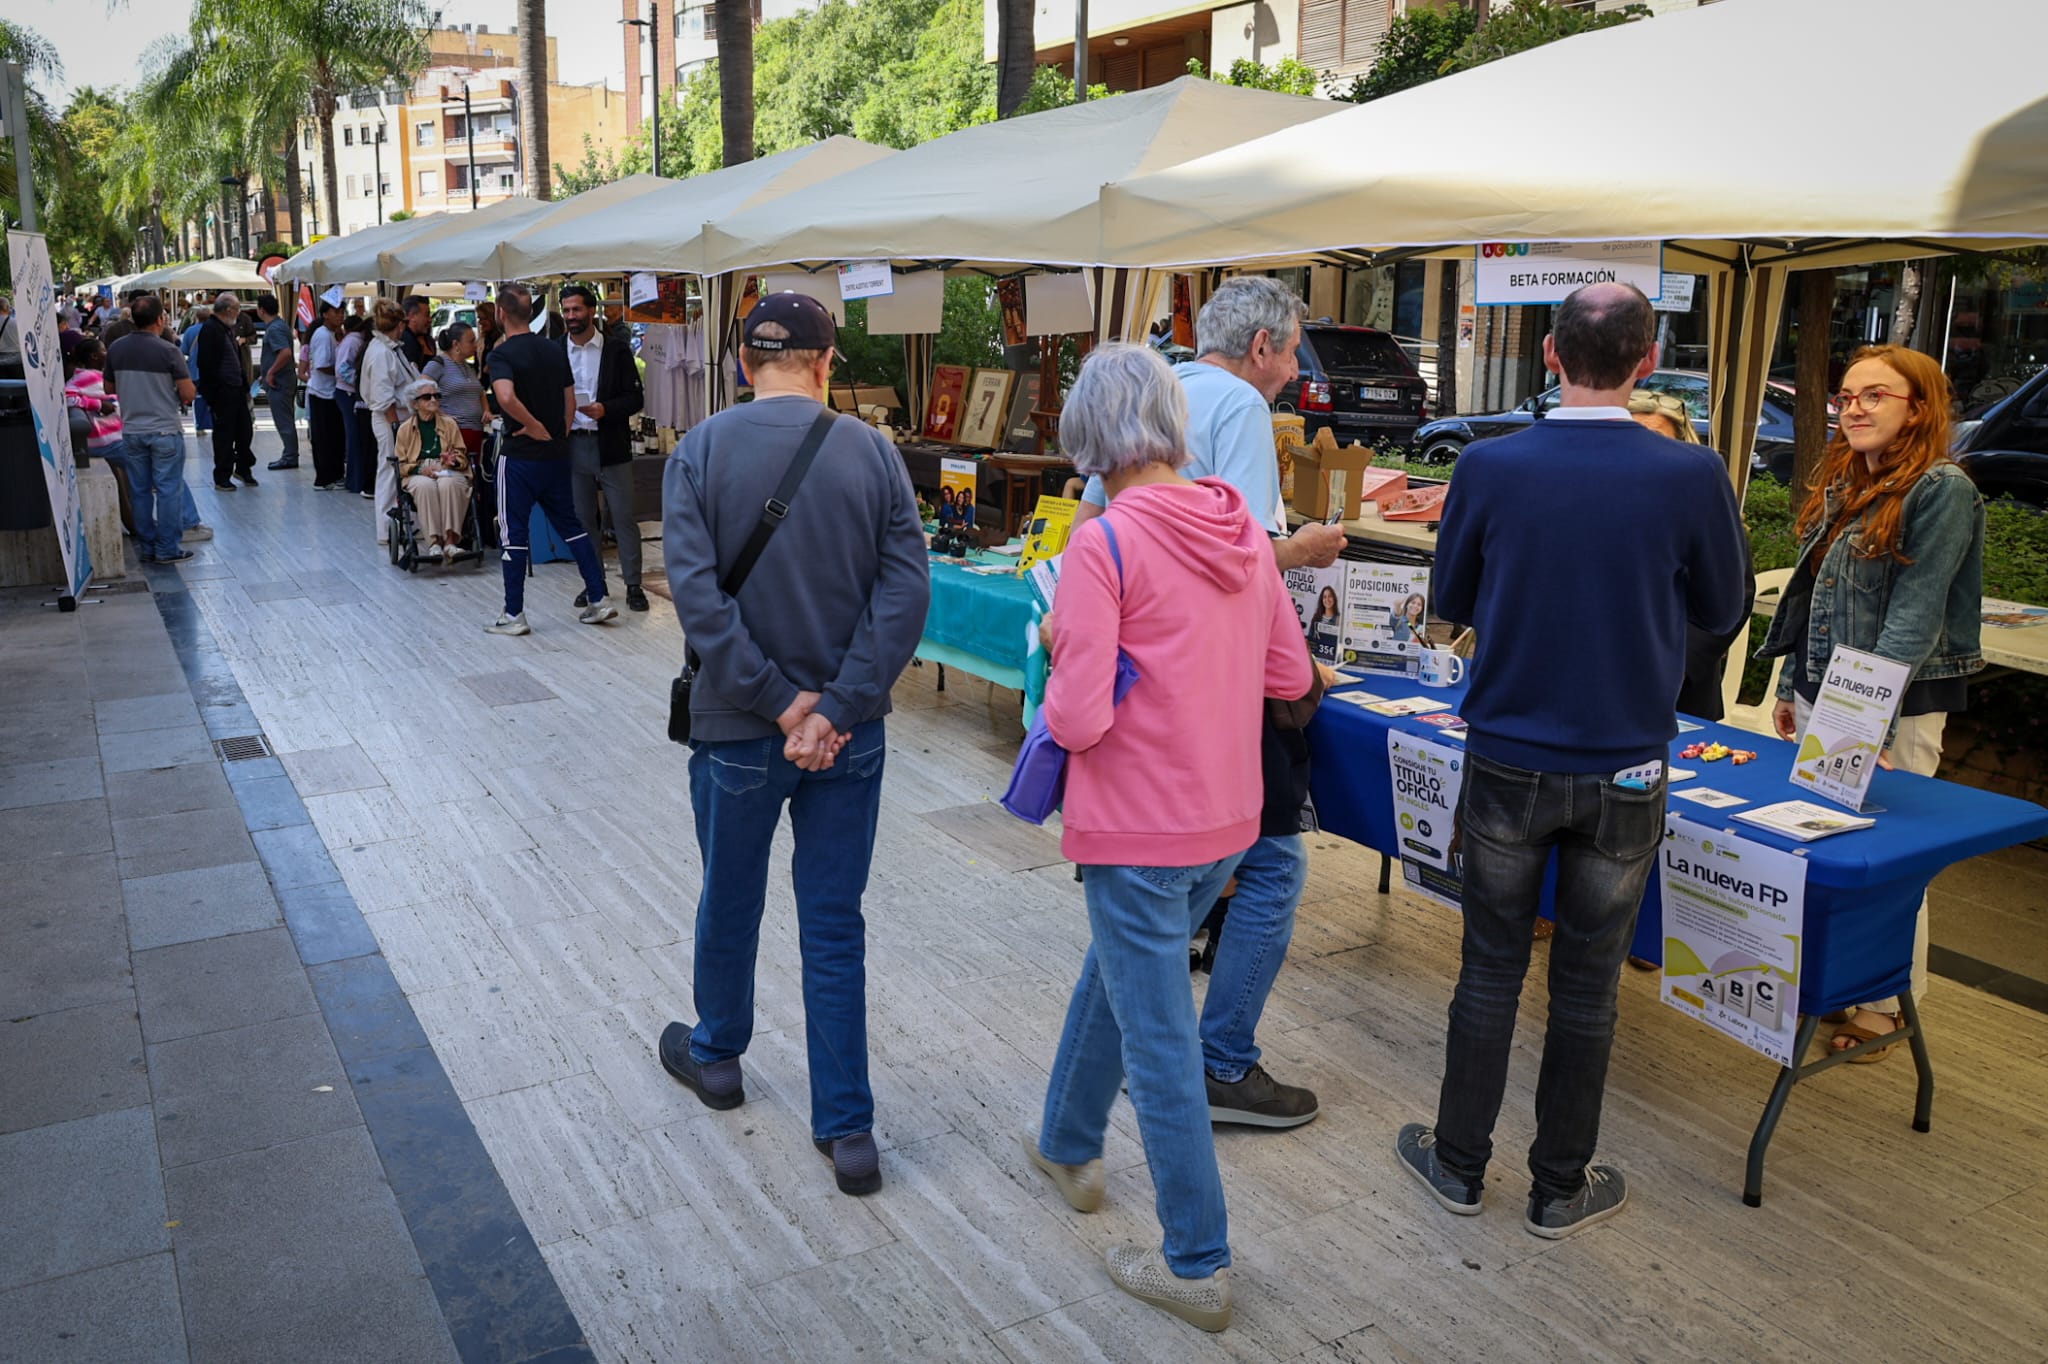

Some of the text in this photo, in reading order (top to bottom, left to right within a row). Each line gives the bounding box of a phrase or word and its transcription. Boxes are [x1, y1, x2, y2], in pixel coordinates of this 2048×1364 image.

[1601, 243, 1611, 252] de
[1509, 267, 1616, 287] BETA FORMACIÓN
[762, 341, 783, 350] VEGAS
[977, 391, 995, 431] 7
[1287, 570, 1314, 584] TITULO
[1286, 580, 1317, 594] OFICIAL
[1349, 579, 1410, 594] OPOSICIONES
[1319, 644, 1335, 656] 35€
[1827, 671, 1841, 687] La
[1841, 678, 1874, 700] nueva
[1874, 686, 1893, 702] FP
[1393, 755, 1426, 773] CONSIGUE
[1427, 766, 1437, 776] TU
[1817, 760, 1825, 769] A
[1834, 757, 1844, 769] B
[1851, 755, 1862, 768] C
[1394, 763, 1440, 792] TITULO
[1396, 778, 1449, 810] OFICIAL
[1666, 850, 1689, 874] La
[1693, 863, 1754, 899] nueva
[1759, 883, 1788, 907] FP
[1701, 979, 1715, 992] A
[1730, 980, 1744, 998] B
[1756, 981, 1774, 1001] C
